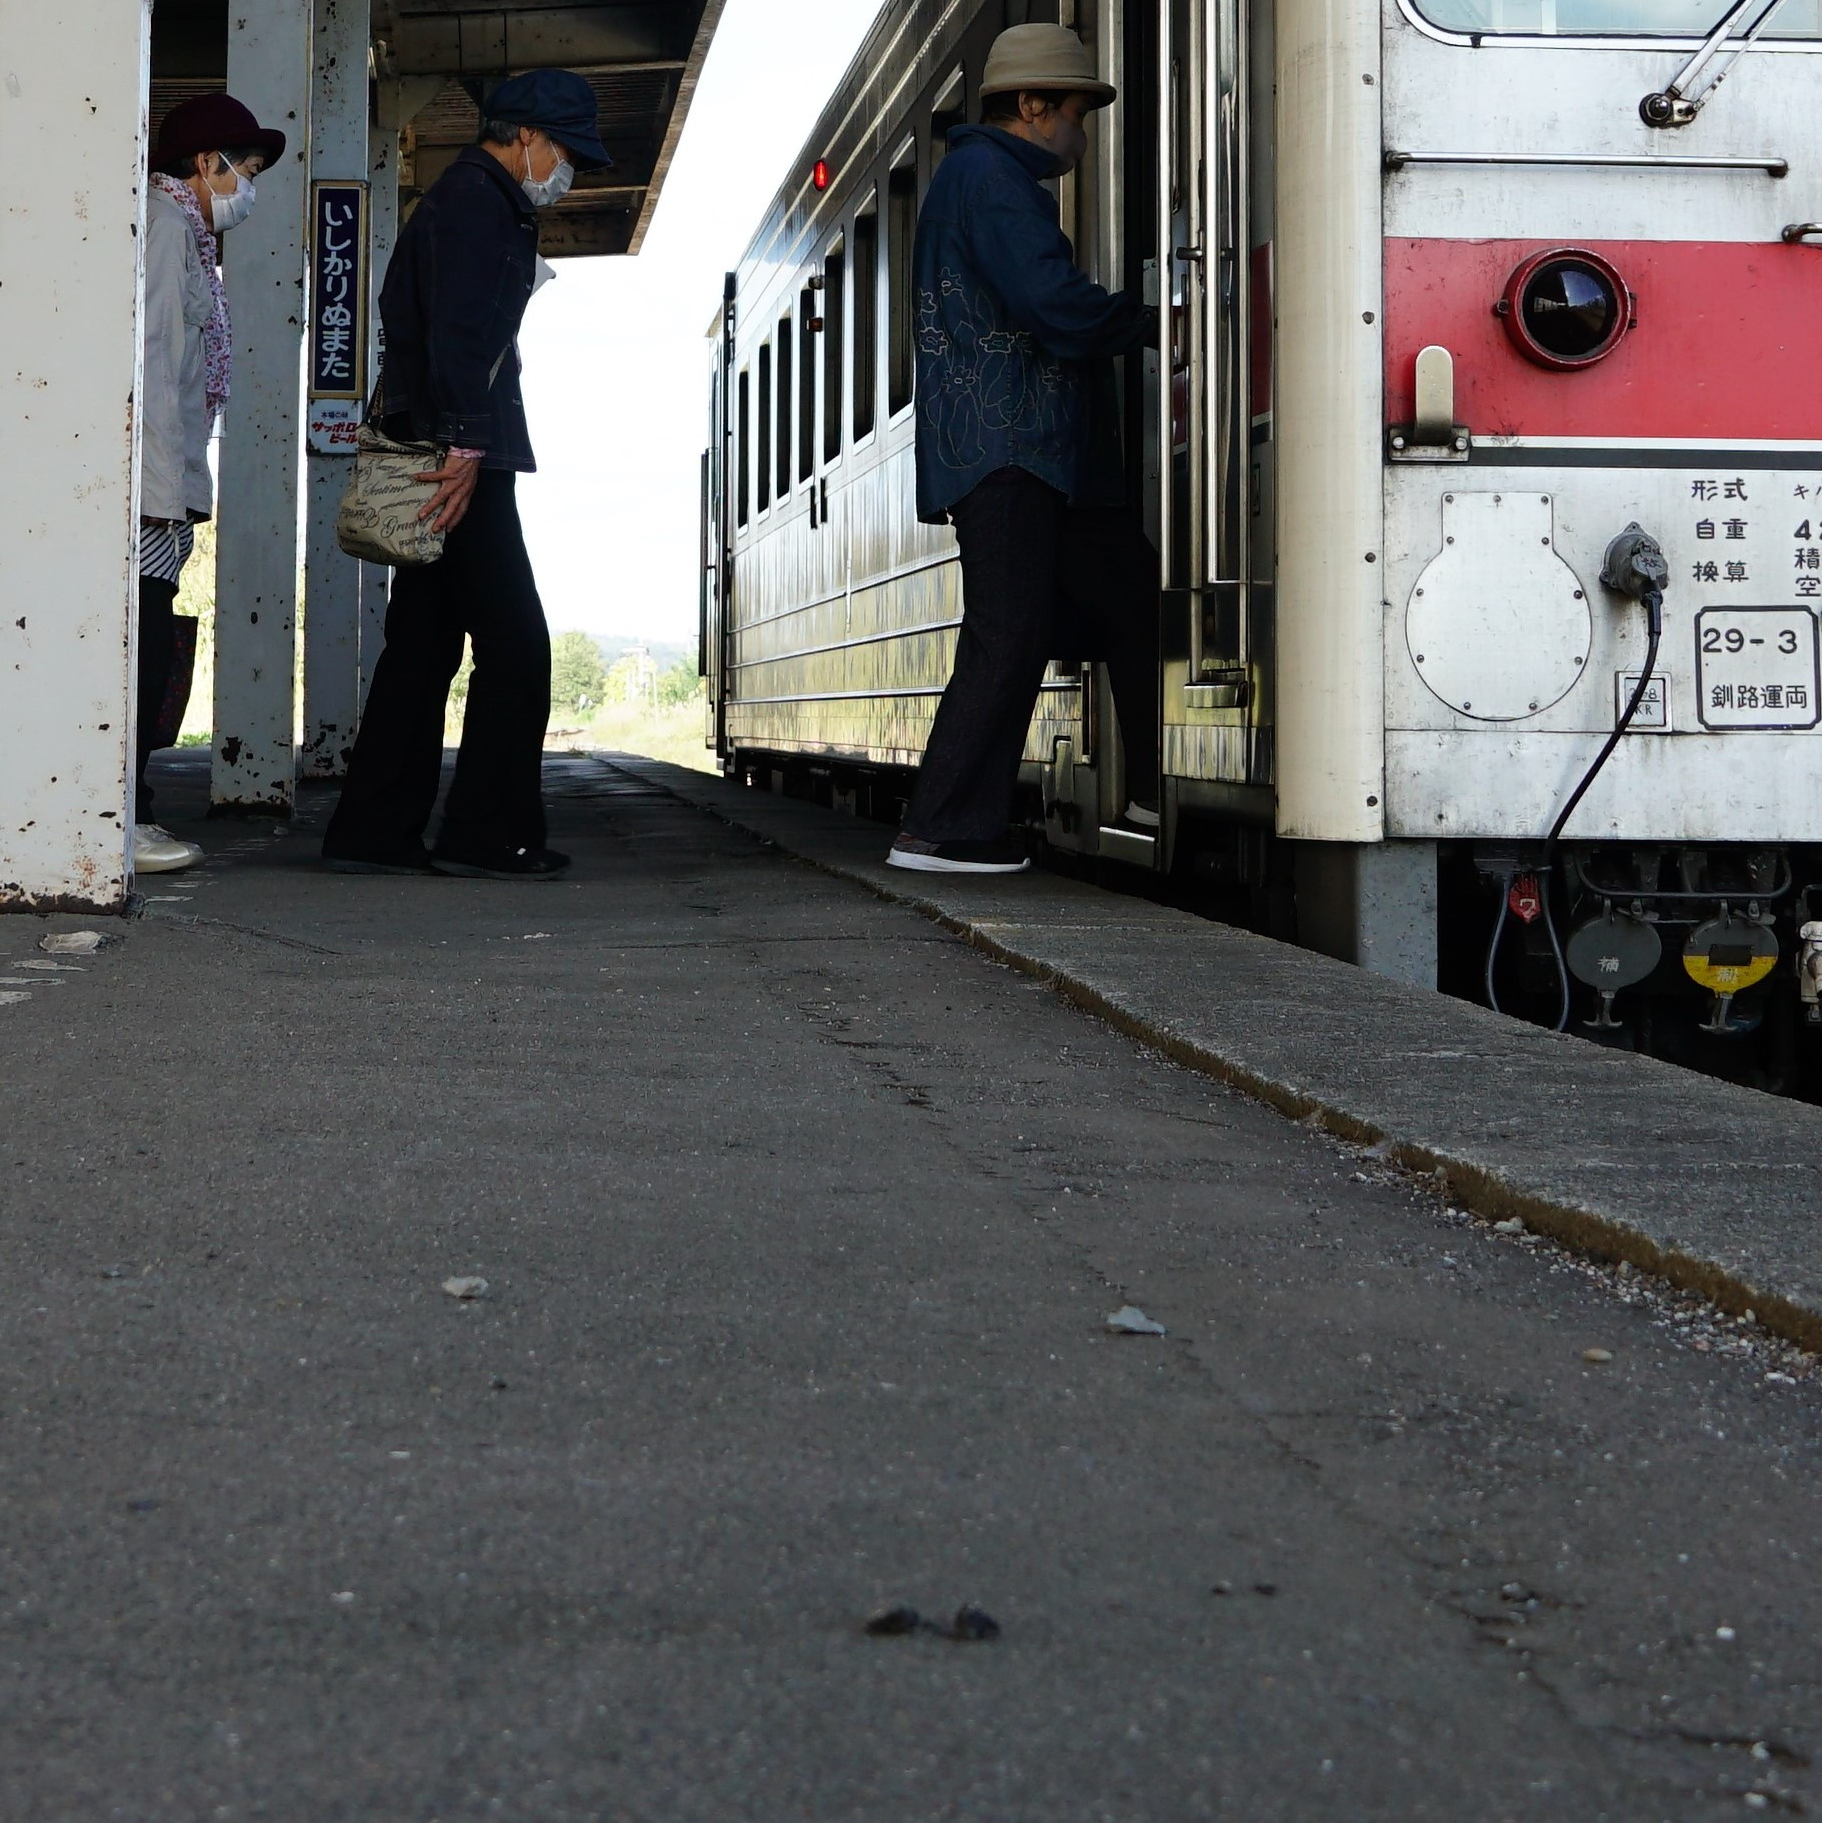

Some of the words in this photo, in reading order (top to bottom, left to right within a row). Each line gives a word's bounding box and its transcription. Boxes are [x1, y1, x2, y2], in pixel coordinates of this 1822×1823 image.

[320, 200, 353, 379] いしかりぬまた
[311, 421, 358, 433] サッポロ
[329, 433, 358, 444] ビール
[1690, 477, 1749, 503] 形式
[1695, 518, 1748, 541] 自重
[1794, 547, 1821, 571] 積
[1692, 559, 1749, 584] 換算
[1795, 575, 1822, 598] 空
[1710, 683, 1809, 711] 釧路運両
